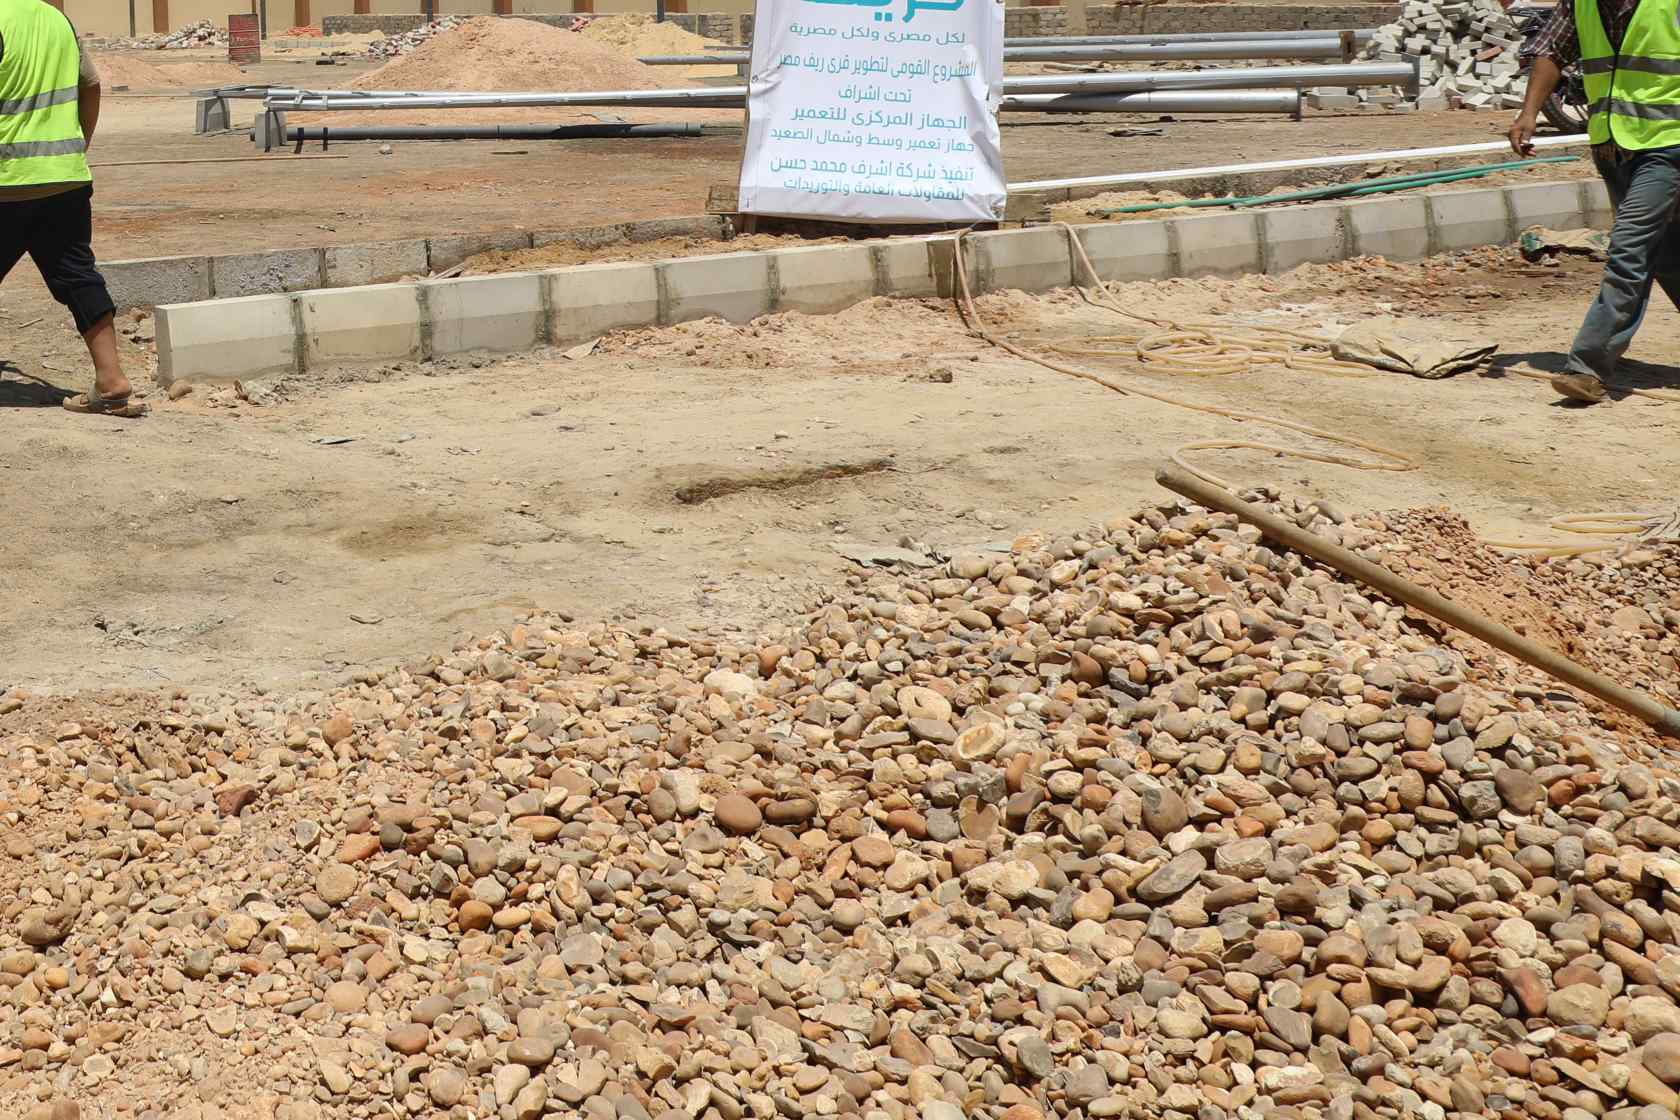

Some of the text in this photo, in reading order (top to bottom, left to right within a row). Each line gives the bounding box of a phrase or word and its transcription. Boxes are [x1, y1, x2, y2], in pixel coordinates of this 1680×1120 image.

[789, 22, 838, 37] مصرية
[842, 25, 880, 41] ولكل
[936, 31, 966, 45] لكل
[803, 52, 825, 72] ريف
[850, 55, 889, 76] لتطوير
[932, 59, 976, 84] المشروع
[883, 88, 913, 103] تحت
[790, 106, 847, 120] للتعمير
[917, 112, 967, 131] الجهاز
[770, 128, 813, 140] الصعيد
[816, 129, 863, 147] وشمال
[866, 132, 903, 150] وسط
[905, 137, 941, 151] تعمير
[770, 157, 807, 172] حسن
[811, 160, 848, 173] محمد
[896, 162, 936, 182] شركة
